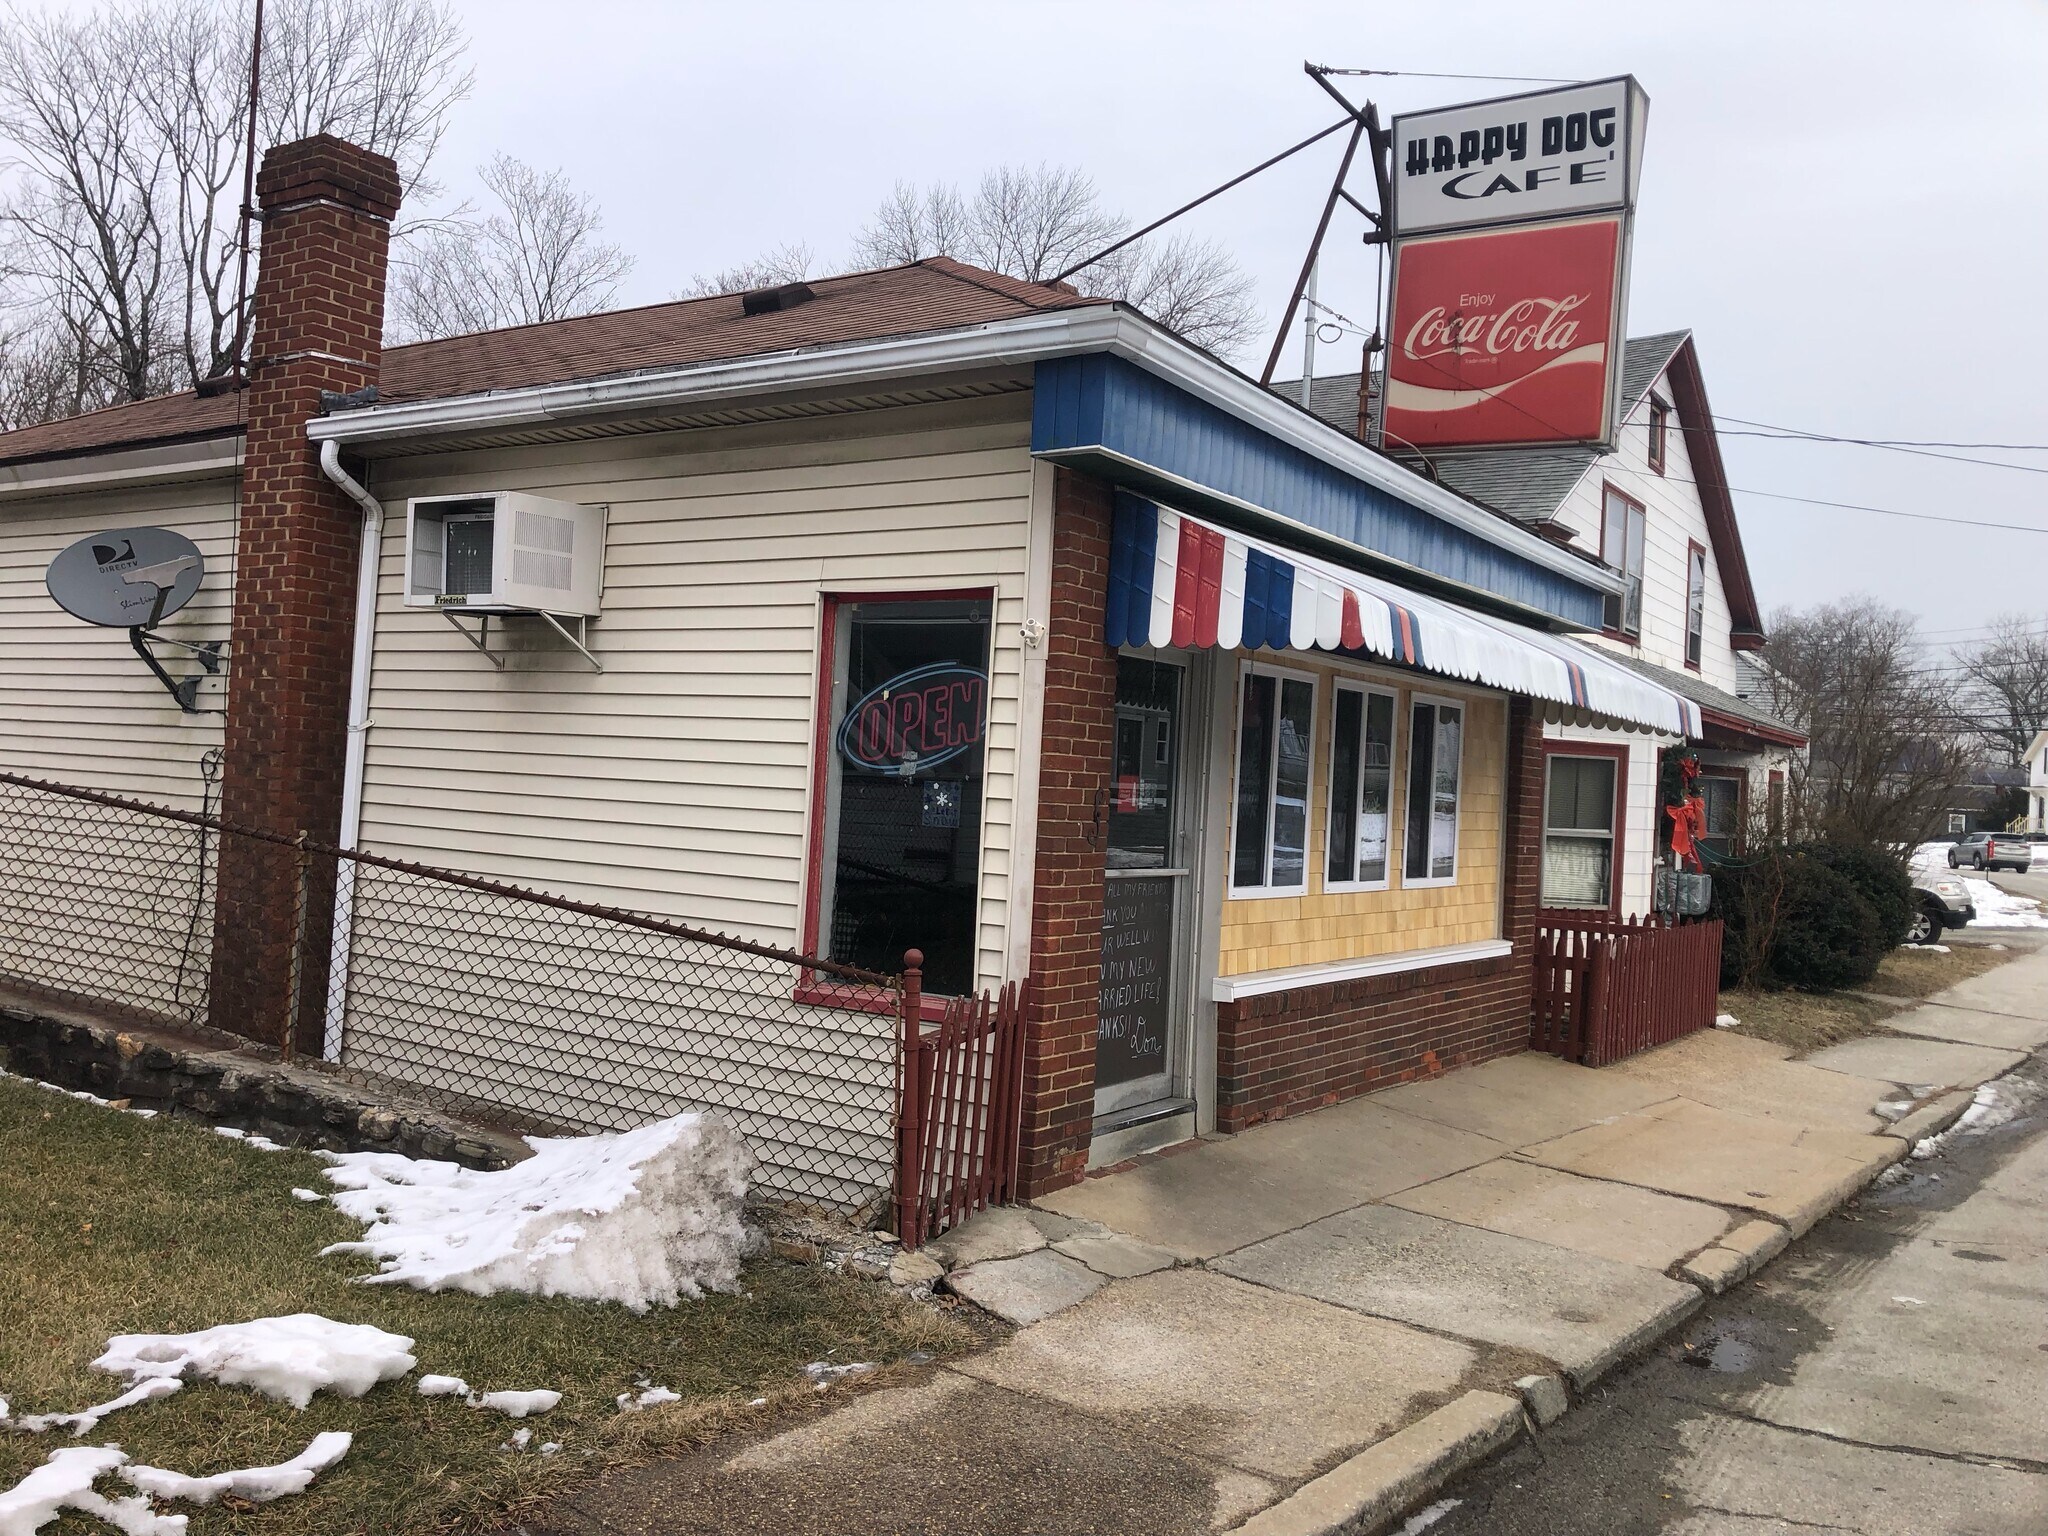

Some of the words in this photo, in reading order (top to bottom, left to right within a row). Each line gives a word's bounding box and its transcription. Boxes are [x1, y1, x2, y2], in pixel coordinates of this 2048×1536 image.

[1405, 121, 1528, 177] HAPPY
[1541, 106, 1616, 156] DOG
[1459, 292, 1496, 308] Enjoy
[1403, 290, 1591, 361] Coca-Cola
[98, 560, 138, 574] DIRECTV
[435, 594, 467, 604] Friedrich
[858, 677, 982, 763] OPEN
[1107, 882, 1121, 898] ALL
[1124, 882, 1137, 897] MY
[1120, 904, 1138, 923] YOU
[1116, 929, 1141, 949] WELL
[1109, 960, 1125, 981] MY
[1128, 956, 1158, 978] NEW
